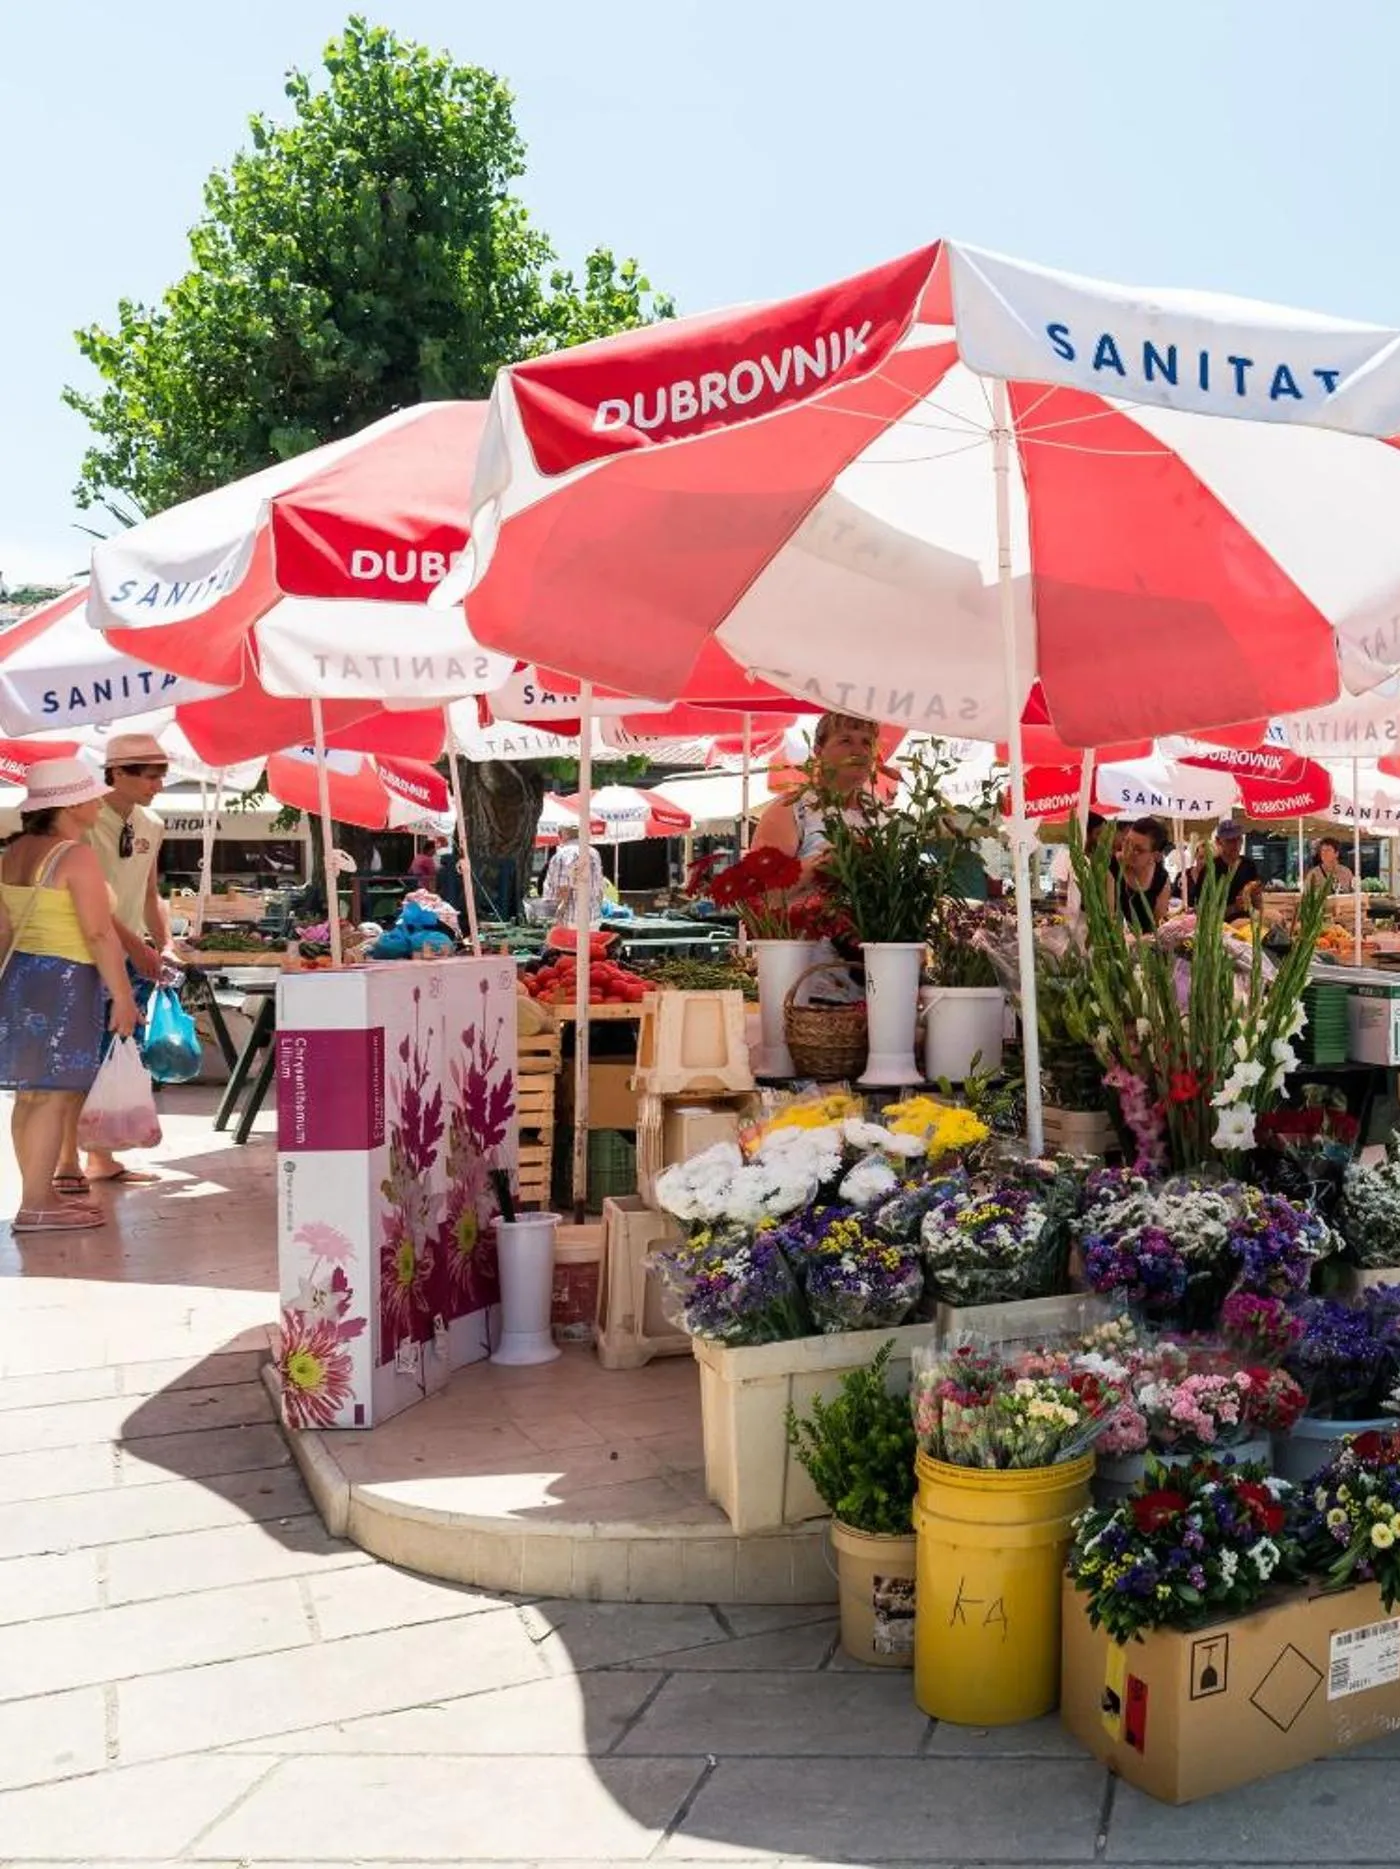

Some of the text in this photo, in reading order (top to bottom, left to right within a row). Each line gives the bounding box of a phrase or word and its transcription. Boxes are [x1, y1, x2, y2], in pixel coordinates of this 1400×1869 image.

[592, 321, 873, 431] DUBROVNIK
[1046, 323, 1340, 400] SANITAT
[1121, 789, 1213, 811] SANITAT
[281, 1037, 292, 1079] Lilium
[294, 1036, 307, 1144] Chrysanthemum
